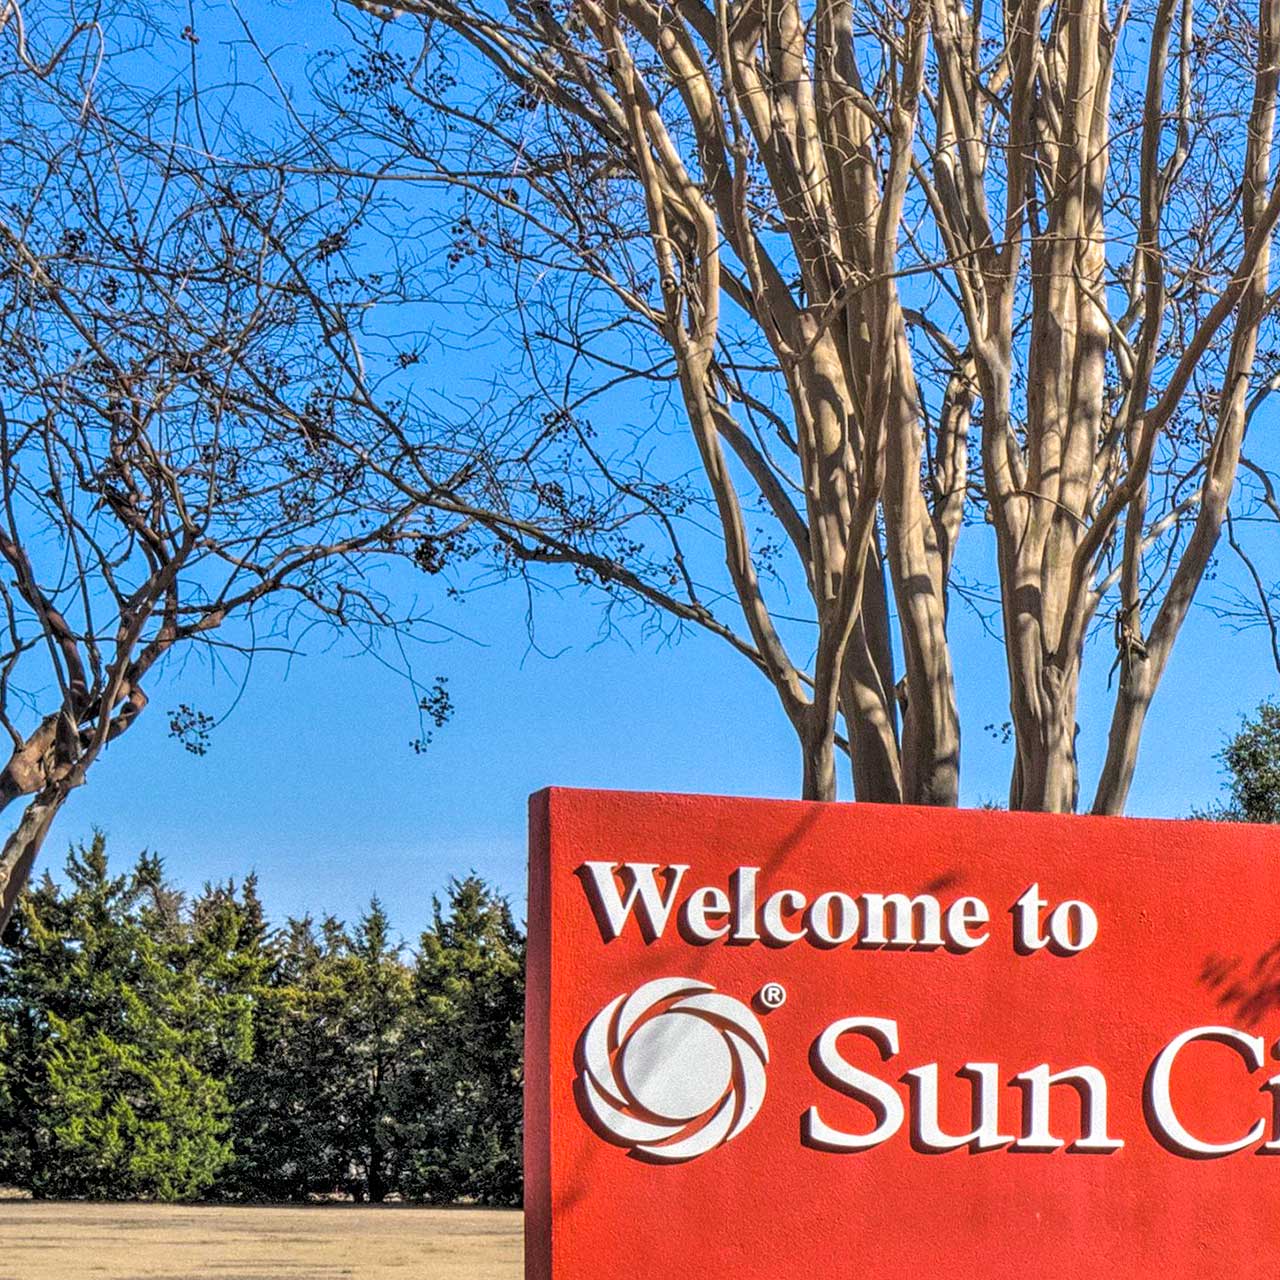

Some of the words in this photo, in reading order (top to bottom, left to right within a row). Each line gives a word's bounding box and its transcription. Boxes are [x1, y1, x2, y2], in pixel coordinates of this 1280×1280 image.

[585, 861, 989, 951] Welcome
[1018, 883, 1098, 951] to
[810, 1016, 1124, 1150] Sun
